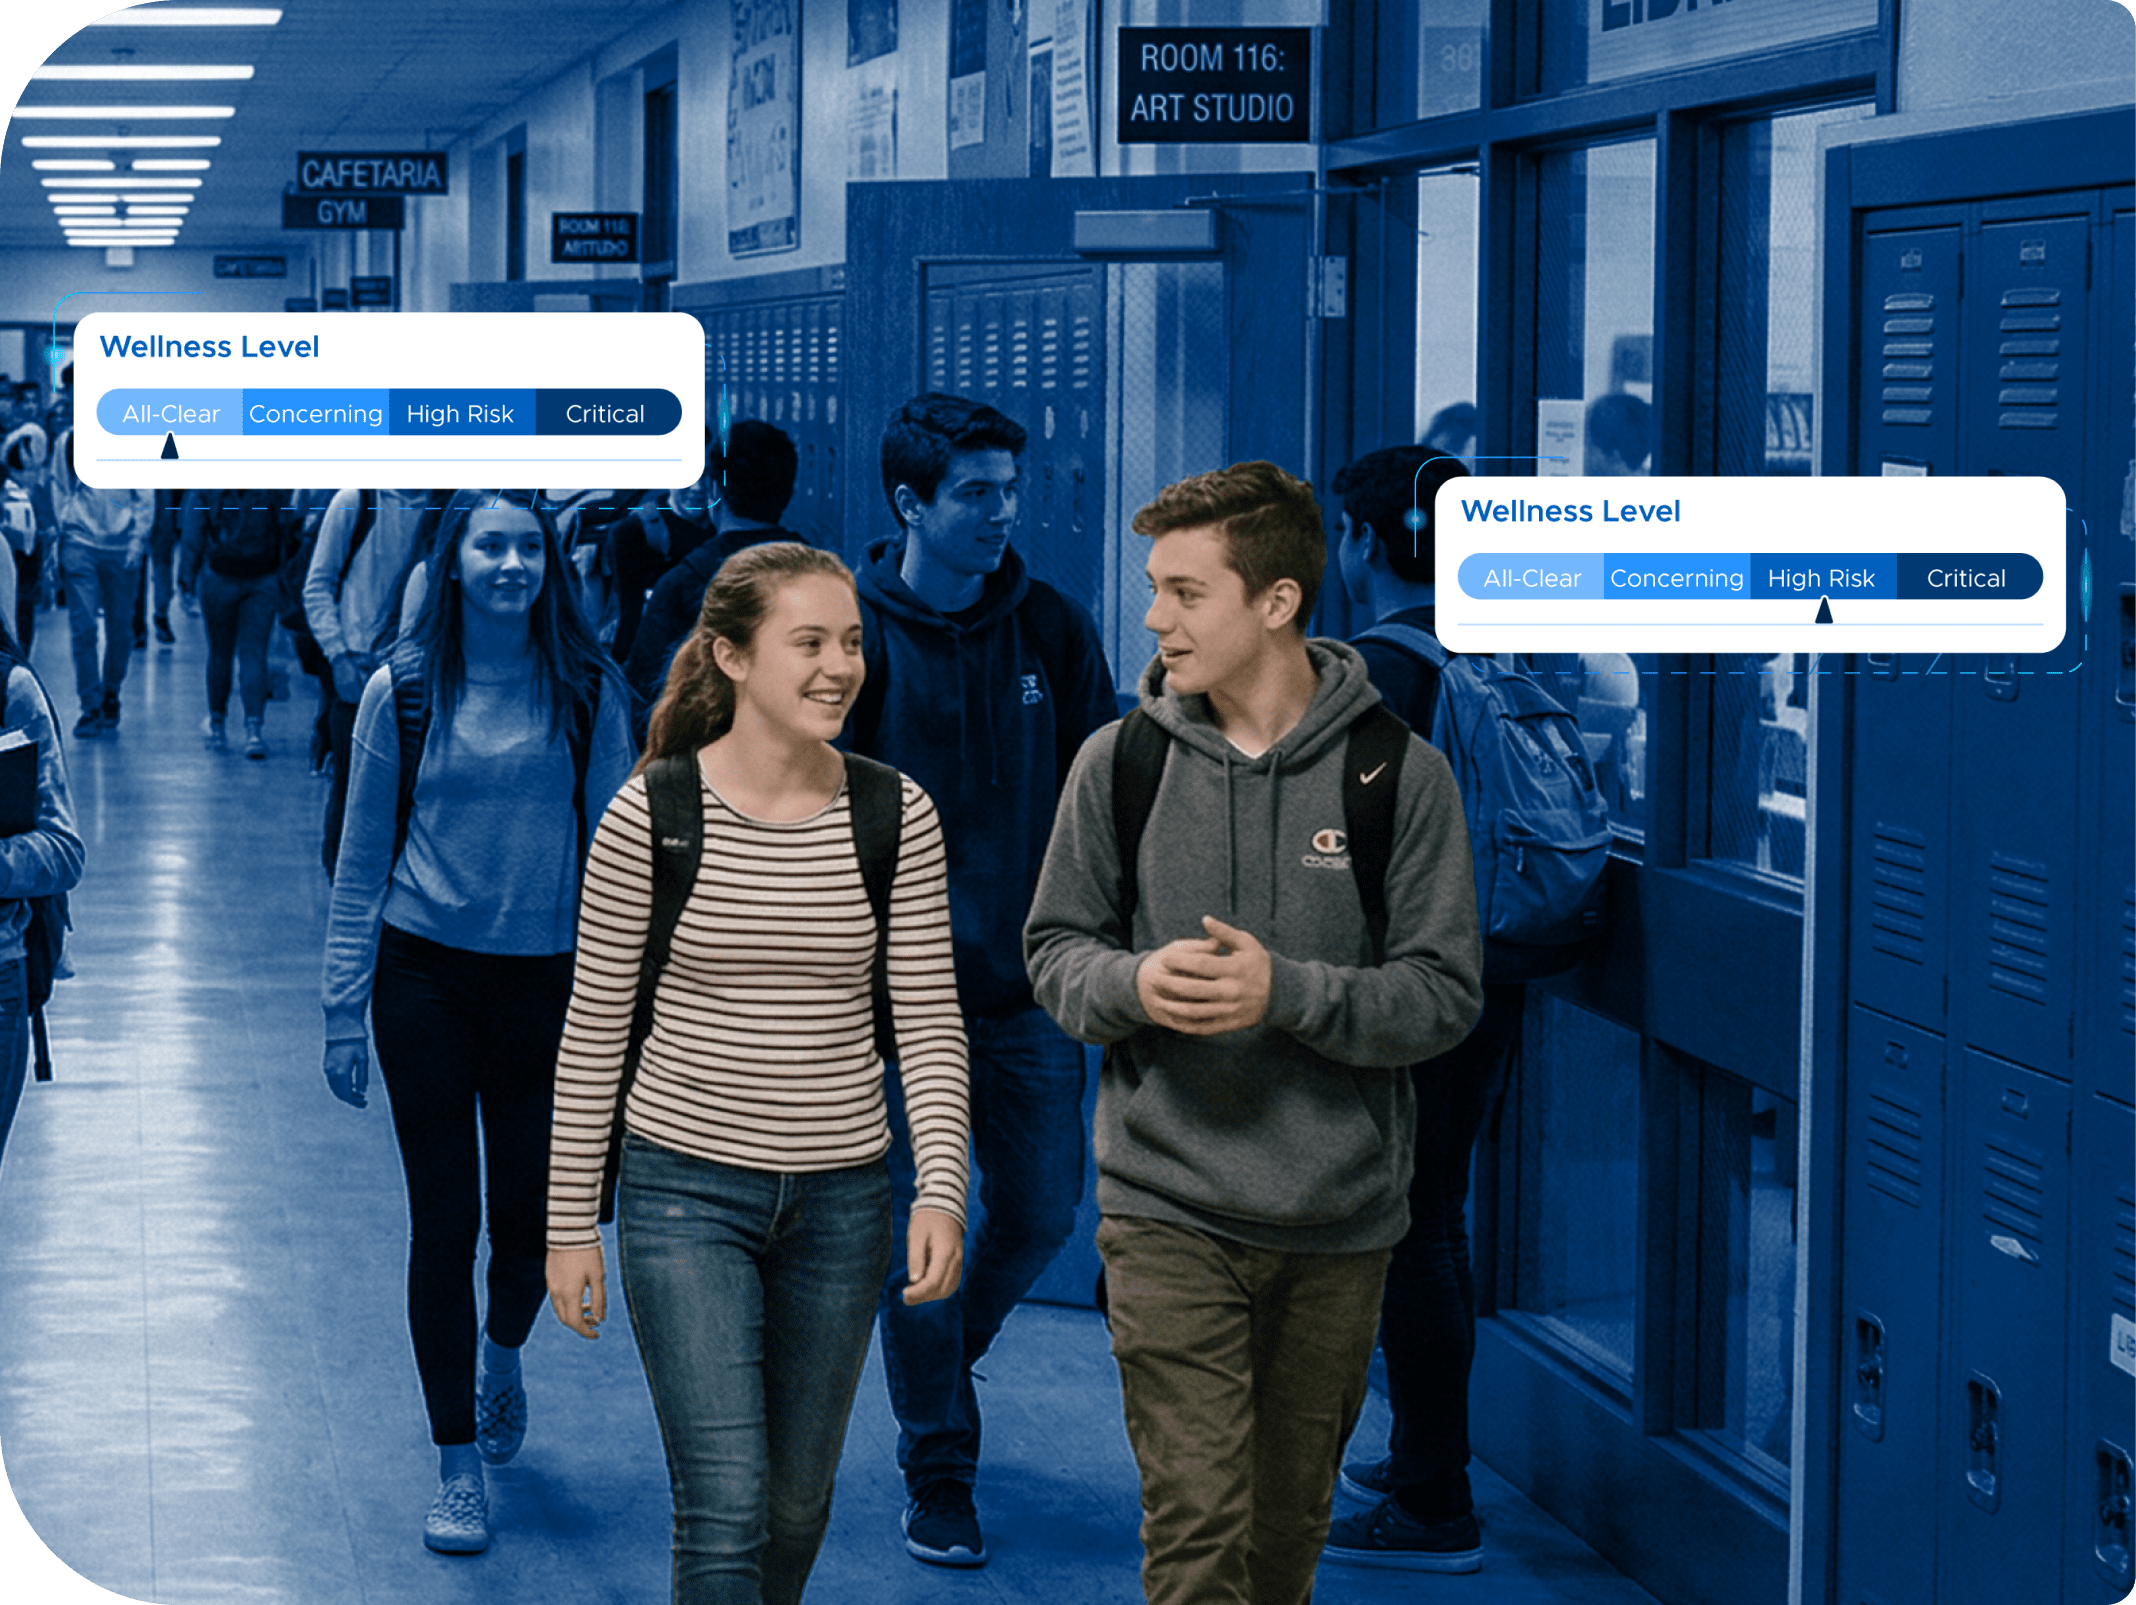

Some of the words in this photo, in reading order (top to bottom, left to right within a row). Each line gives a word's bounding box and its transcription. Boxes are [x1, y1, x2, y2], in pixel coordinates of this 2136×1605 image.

[1141, 43, 1223, 72] ROOM
[1233, 43, 1285, 72] 116:
[1130, 93, 1186, 122] ART
[1192, 93, 1294, 122] STUDIO
[302, 158, 442, 189] CAFETARIA
[316, 199, 367, 225] GYM
